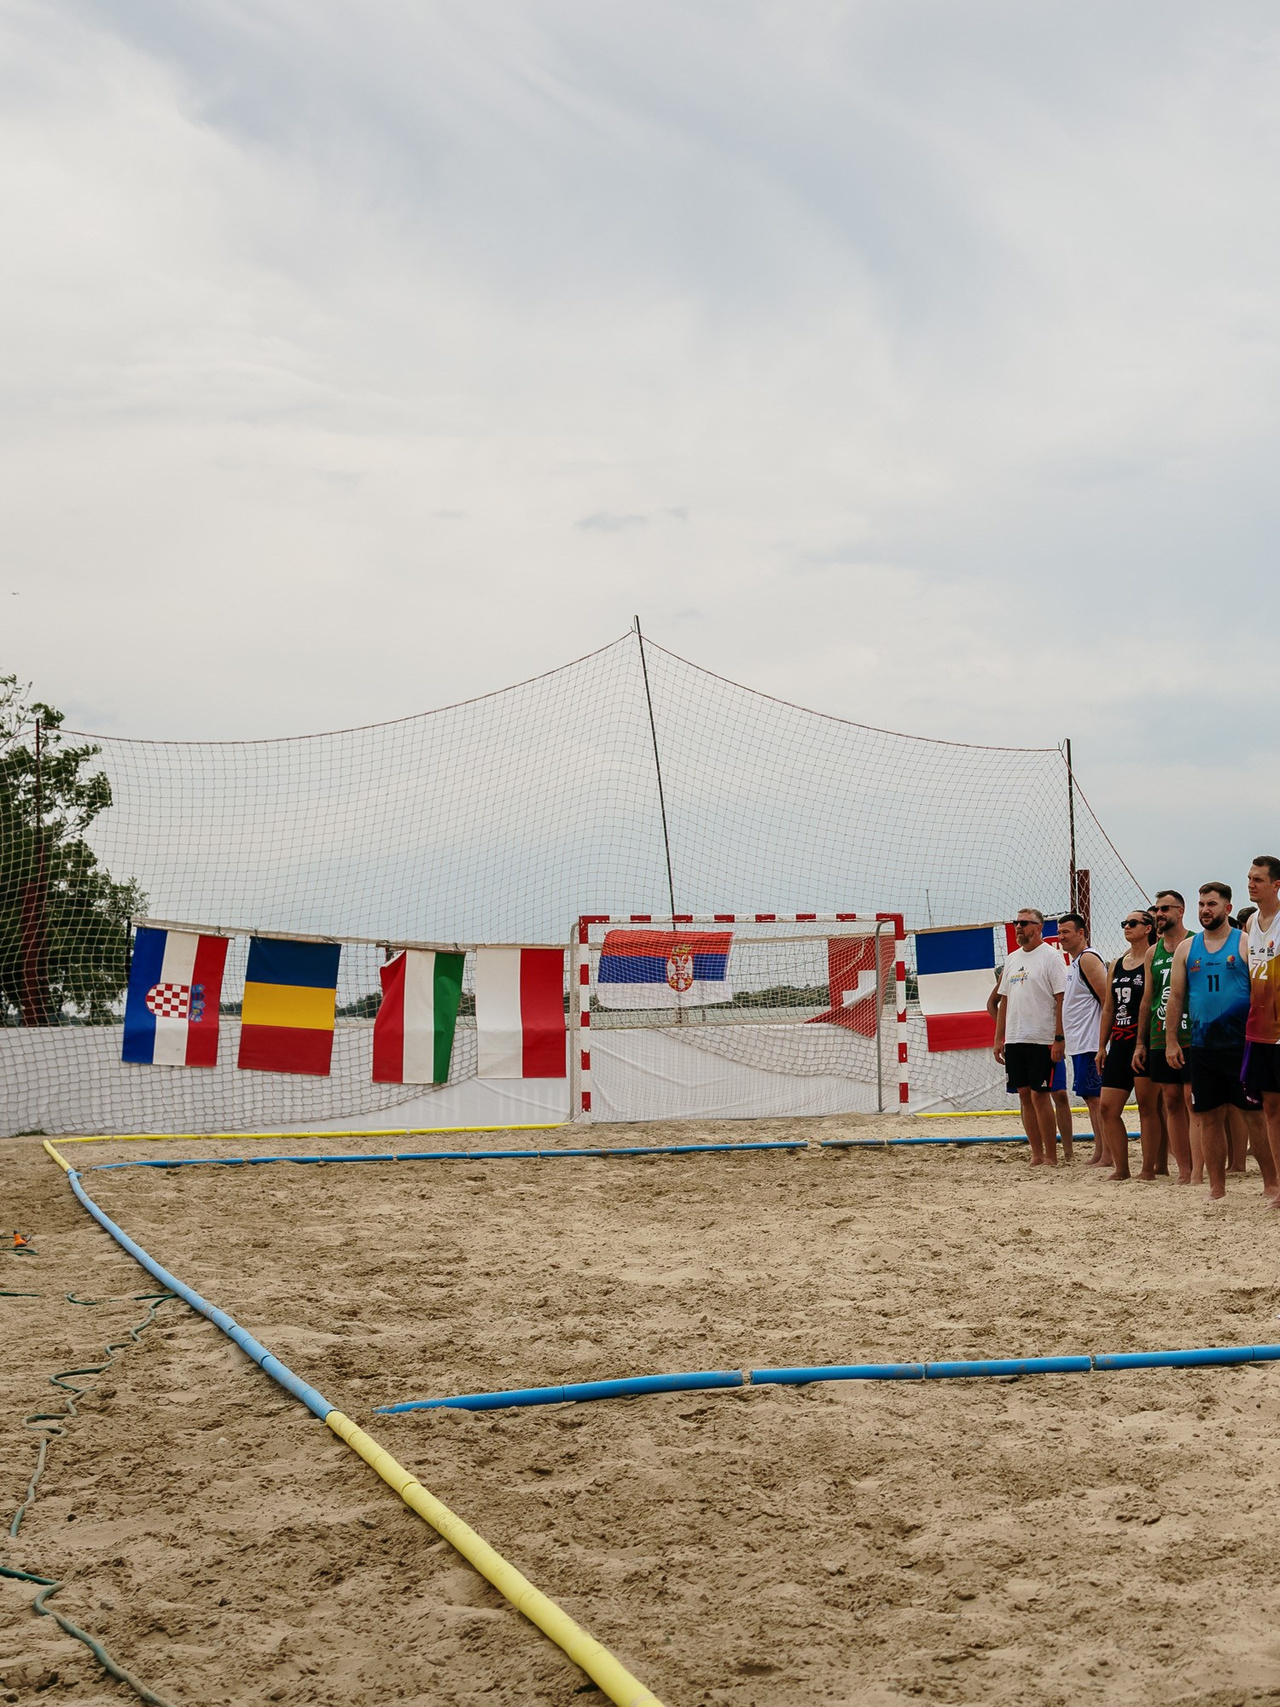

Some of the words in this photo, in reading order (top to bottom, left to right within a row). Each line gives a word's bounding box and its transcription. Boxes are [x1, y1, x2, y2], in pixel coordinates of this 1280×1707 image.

[1252, 959, 1268, 979] 72
[1207, 974, 1219, 993] 11
[1115, 987, 1131, 1003] 19
